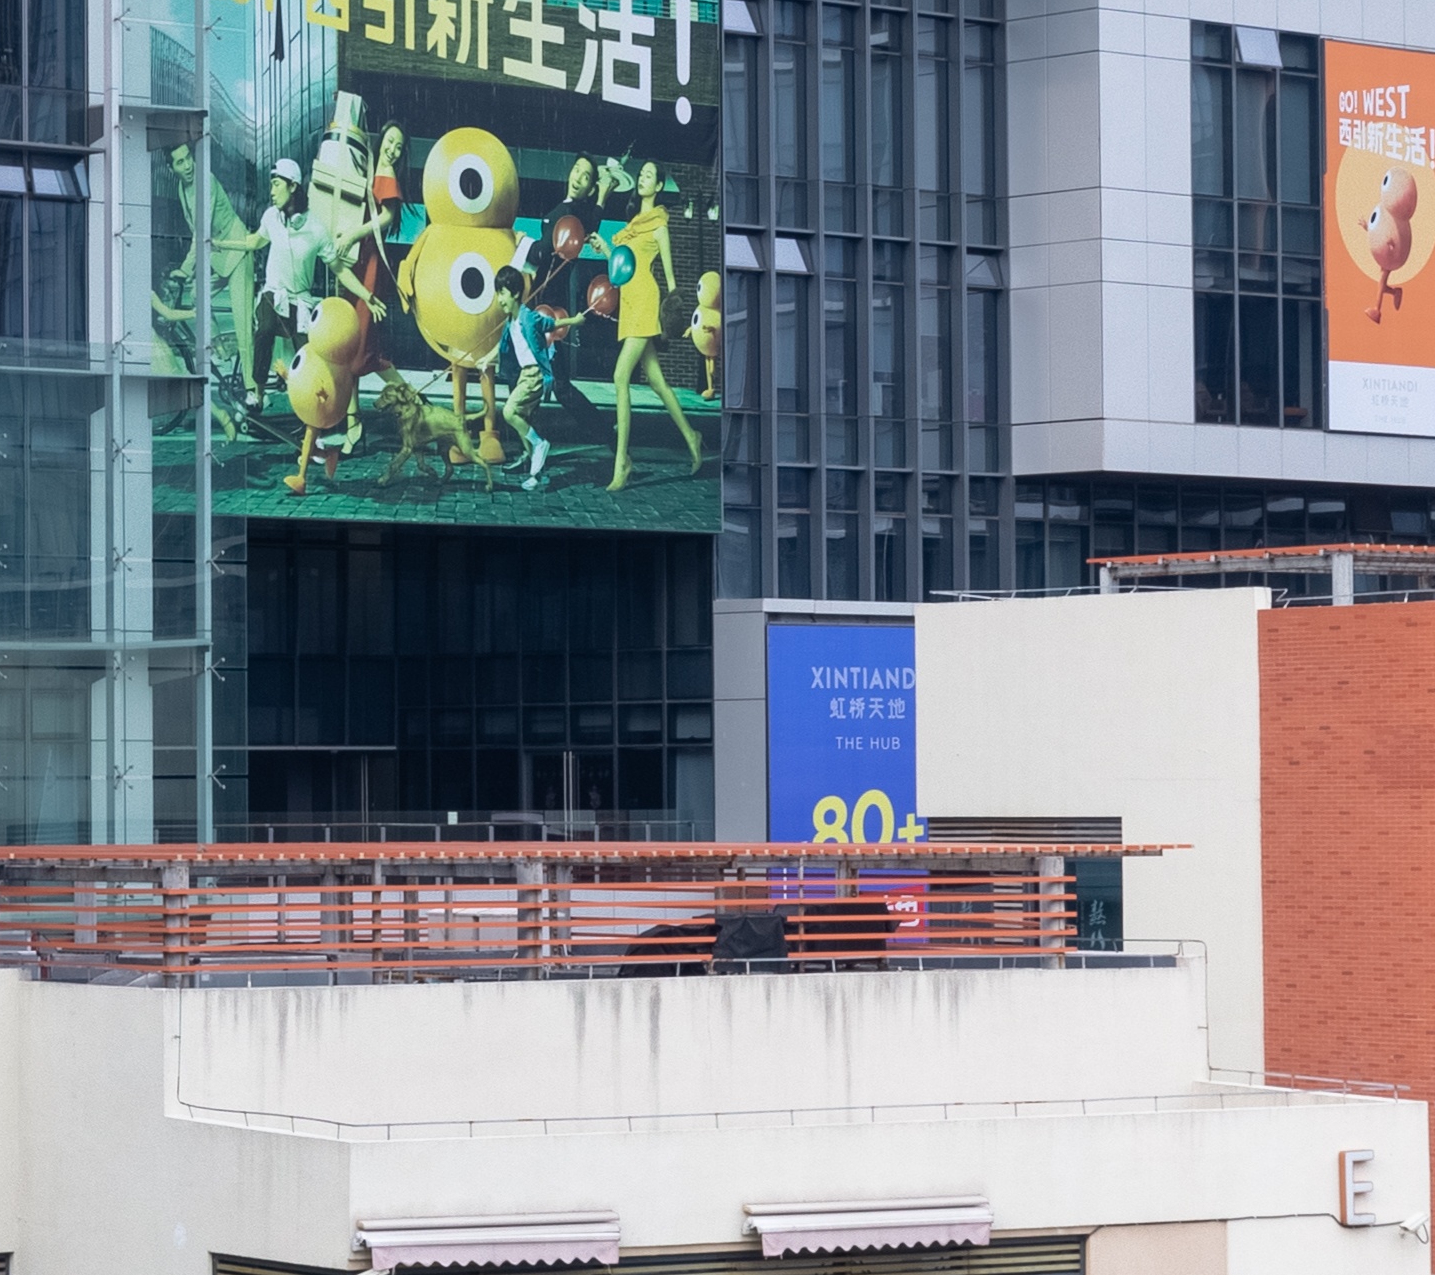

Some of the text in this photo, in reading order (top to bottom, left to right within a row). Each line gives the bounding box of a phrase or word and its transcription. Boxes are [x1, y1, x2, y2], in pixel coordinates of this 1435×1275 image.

[1338, 84, 1411, 120] GO! WEST
[1338, 117, 1435, 170] 西引新生活!
[1362, 377, 1418, 393] XINTIANDI
[830, 697, 906, 719] 虹桥天地
[835, 736, 901, 750] THE HUB
[812, 789, 925, 843] 80+
[1338, 1149, 1376, 1225] E
